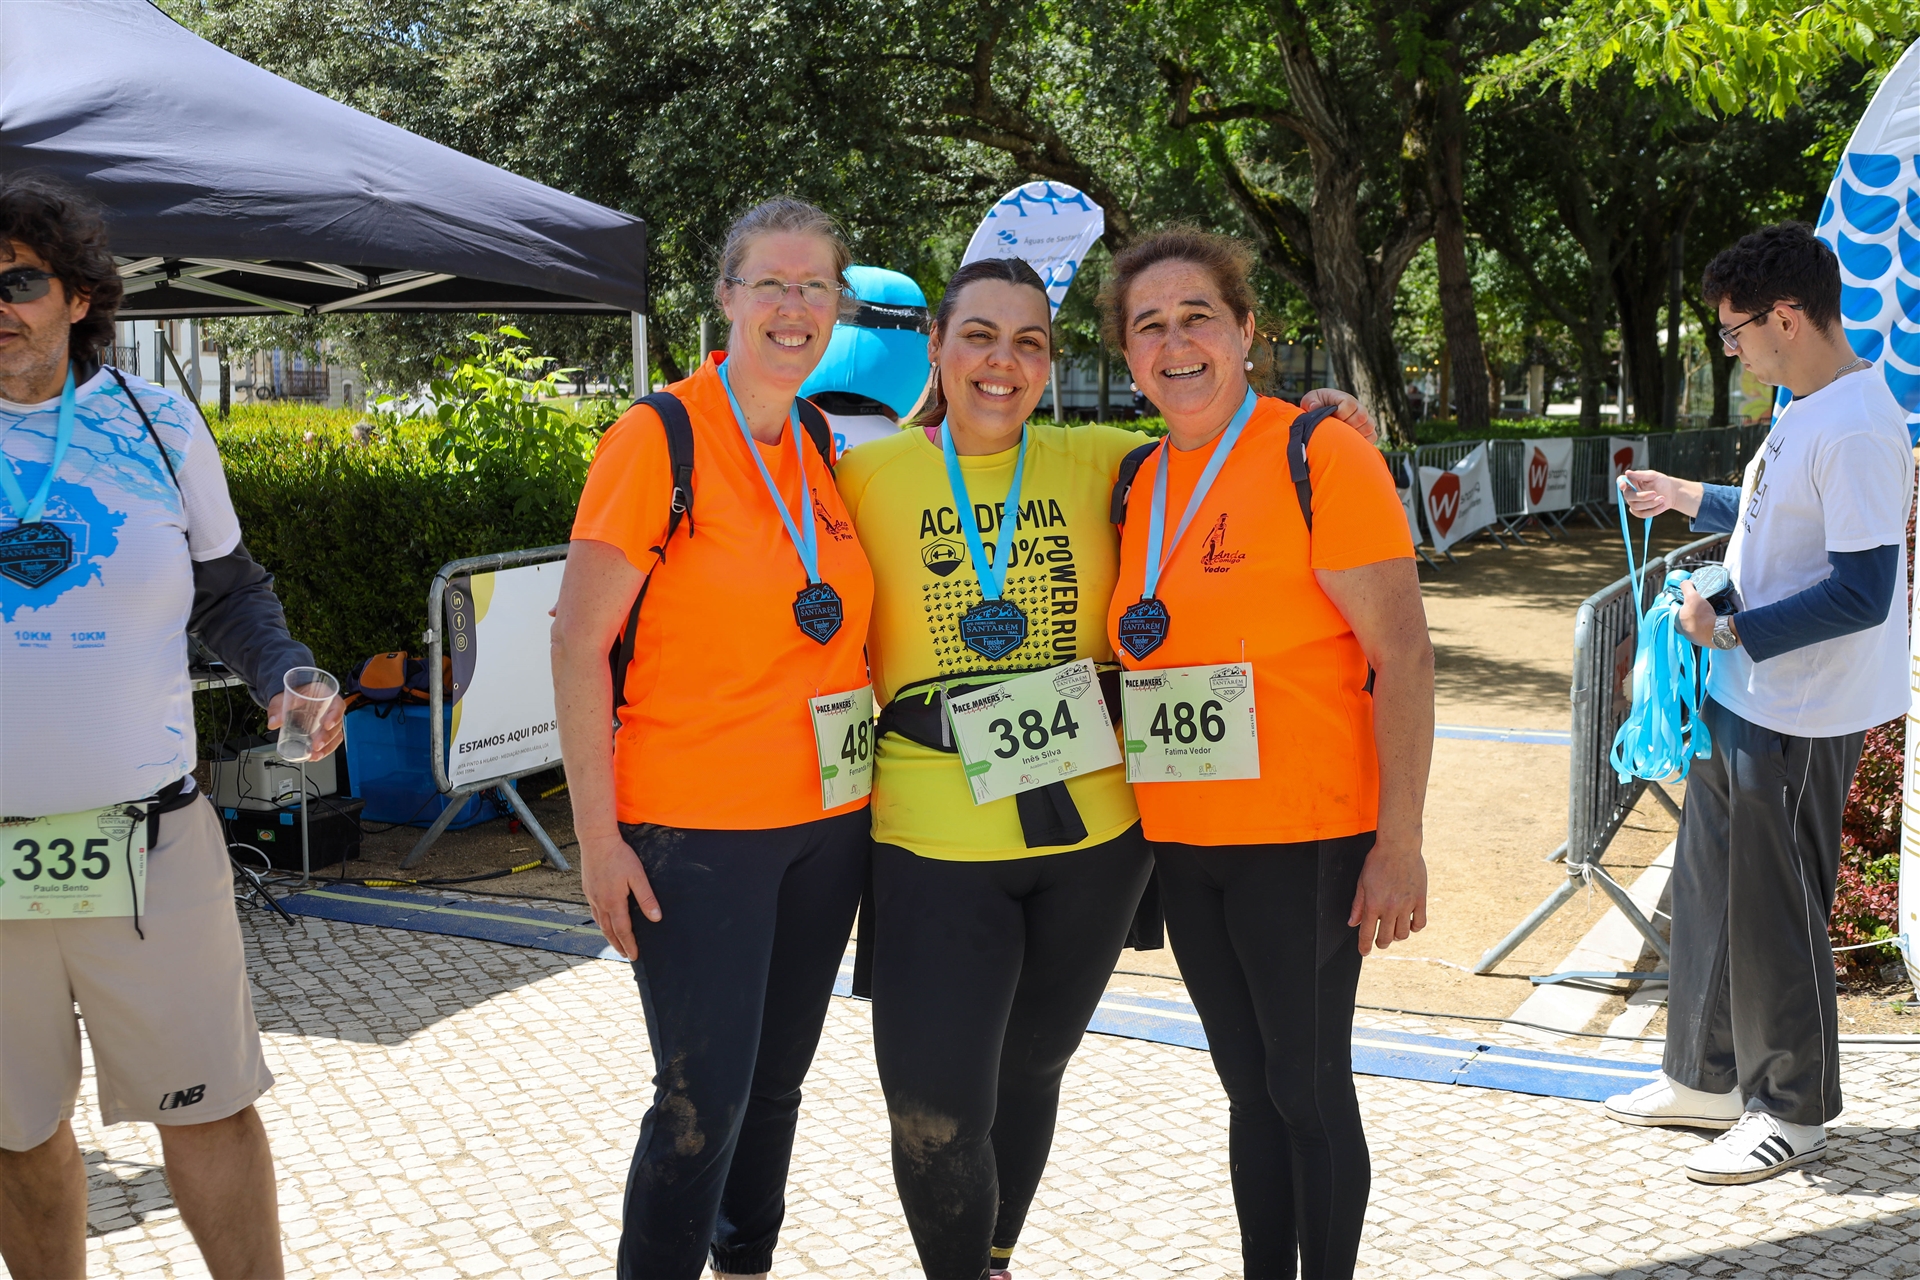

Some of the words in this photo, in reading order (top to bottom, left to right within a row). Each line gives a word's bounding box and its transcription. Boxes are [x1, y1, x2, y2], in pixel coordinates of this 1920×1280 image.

[1531, 464, 1548, 488] W
[1431, 490, 1459, 522] W
[800, 605, 837, 617] SANTARÉM
[966, 622, 1020, 633] SANTARÉM
[1123, 620, 1161, 631] SANTARÉM
[14, 631, 52, 641] 10KM
[70, 631, 106, 642] 10KM
[983, 636, 1006, 646] Finisher
[1125, 678, 1163, 688] PACE.MAKERS
[816, 700, 852, 714] PACE.MAKERS
[952, 693, 1001, 714] PACE.MAKERS
[1150, 699, 1226, 744] 486
[988, 699, 1080, 759] 384
[458, 733, 506, 754] ESTAMOS
[506, 726, 530, 743] AQUI
[531, 721, 549, 736] POR
[1022, 754, 1040, 765] Inês
[1041, 748, 1062, 760] Silva
[1165, 747, 1188, 756] Fatima
[1189, 746, 1212, 755] Vedor
[482, 755, 499, 763] HILÁRIO
[12, 838, 110, 881] 335
[33, 884, 60, 892] Paulo
[62, 884, 89, 892] Bento
